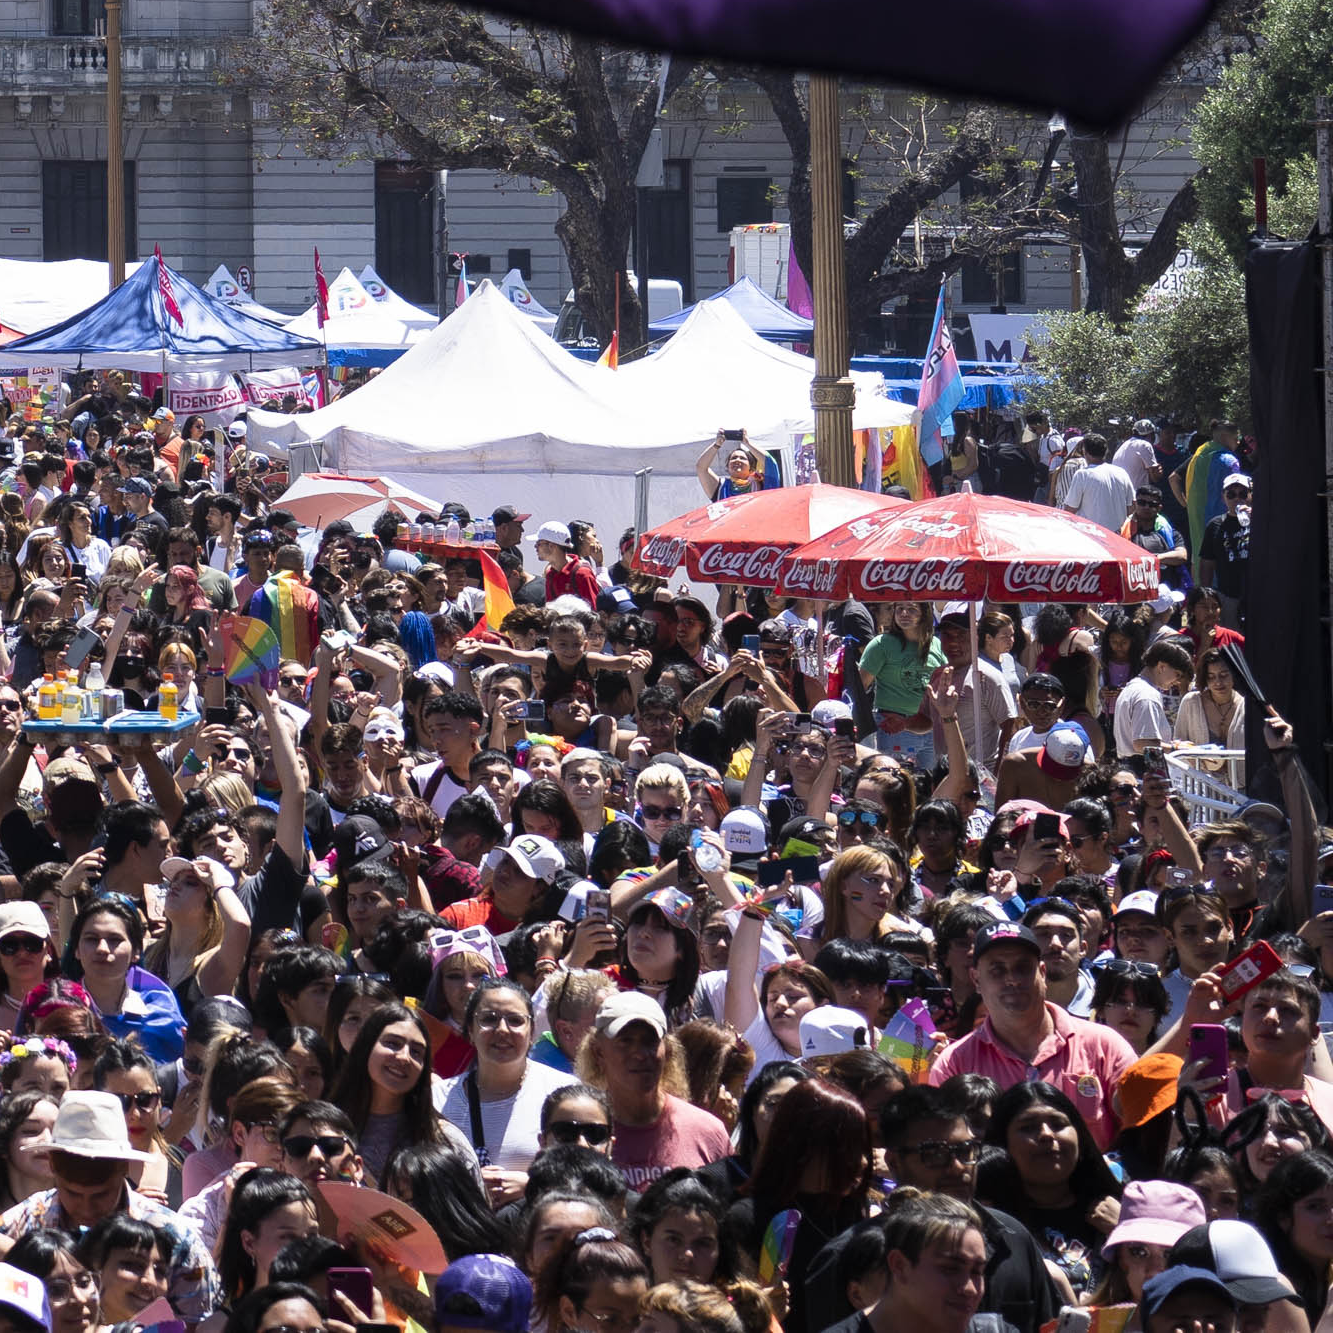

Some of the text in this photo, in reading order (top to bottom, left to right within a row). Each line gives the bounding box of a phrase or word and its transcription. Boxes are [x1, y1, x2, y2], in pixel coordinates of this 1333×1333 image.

[698, 543, 792, 580] Coca-Col
[860, 557, 968, 592] Coca-Cola
[1003, 559, 1105, 594] Coca-Cola
